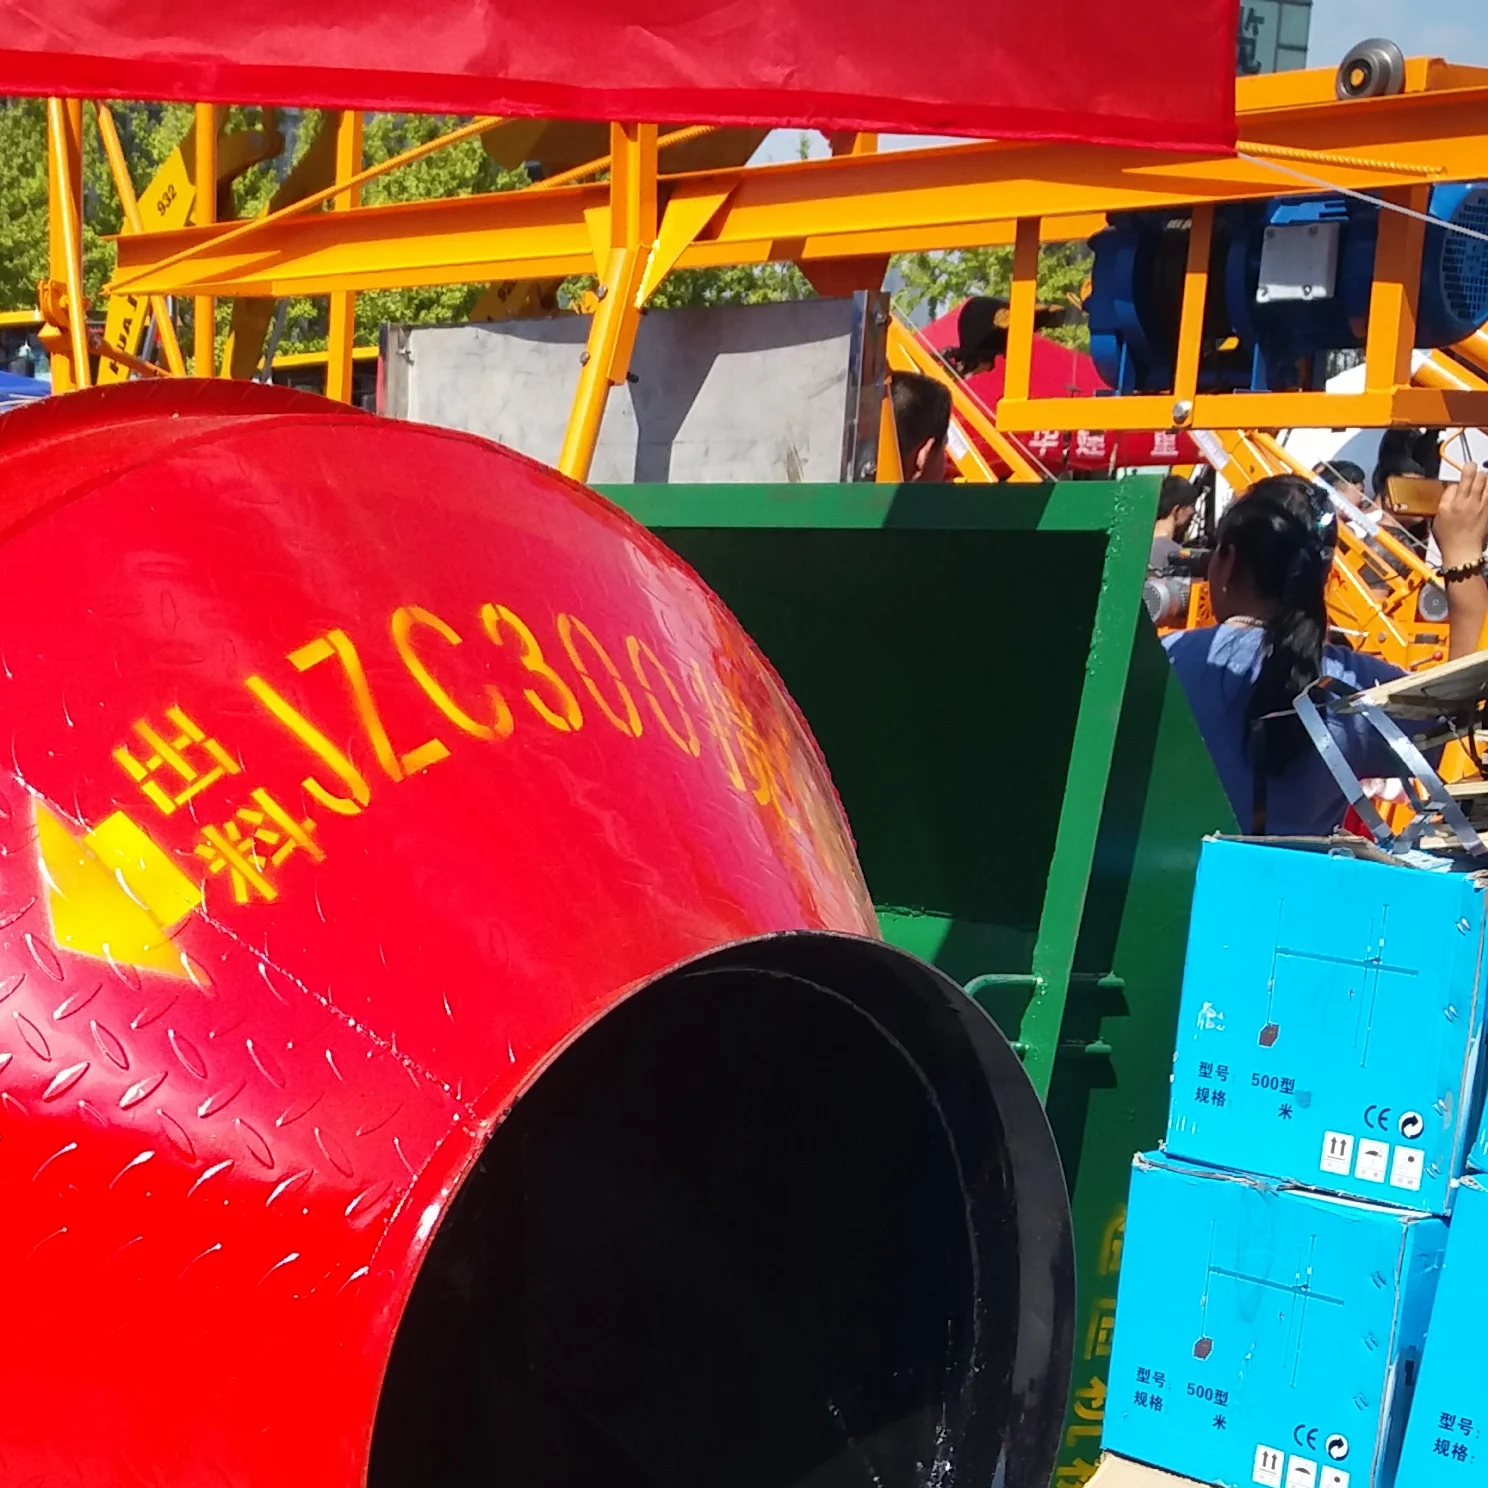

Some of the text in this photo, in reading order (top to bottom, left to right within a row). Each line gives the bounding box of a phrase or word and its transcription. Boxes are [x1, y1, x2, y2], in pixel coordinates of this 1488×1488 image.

[156, 182, 178, 217] 932
[244, 603, 701, 815] JZC300
[113, 703, 326, 904] 出料
[1252, 1073, 1295, 1095] 500型
[1278, 1103, 1293, 1120] 米
[1364, 1105, 1391, 1131] CE
[1187, 1383, 1229, 1407] 500型
[1213, 1414, 1227, 1430] 米
[1294, 1424, 1319, 1450] CE
